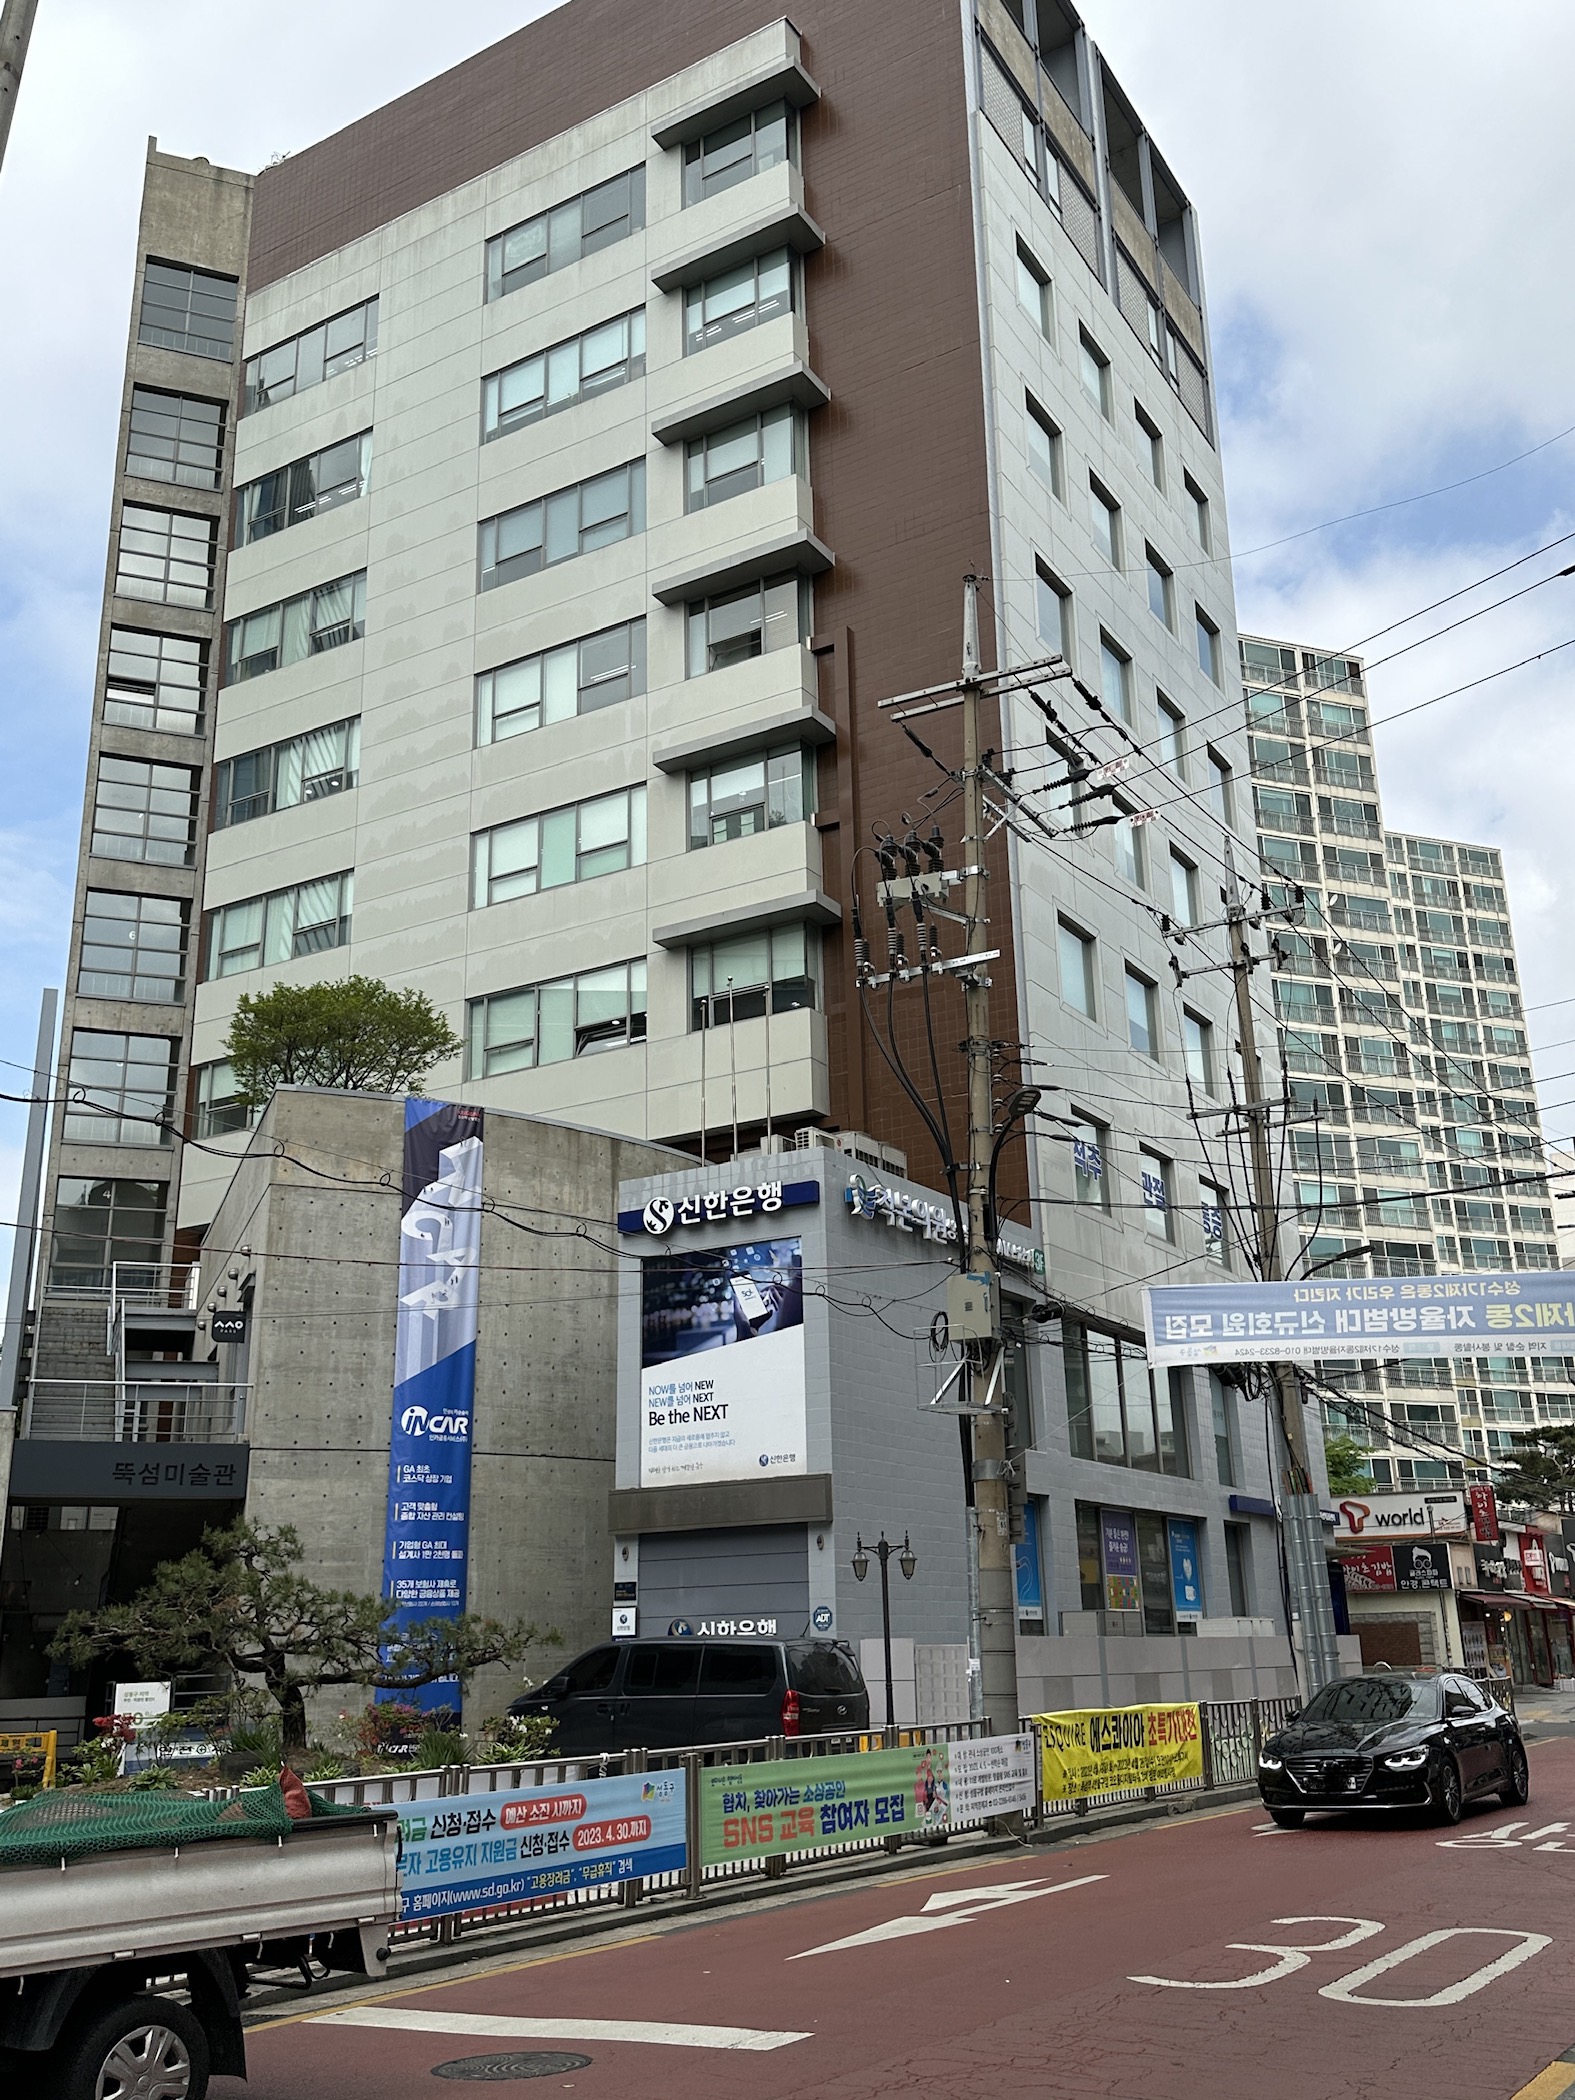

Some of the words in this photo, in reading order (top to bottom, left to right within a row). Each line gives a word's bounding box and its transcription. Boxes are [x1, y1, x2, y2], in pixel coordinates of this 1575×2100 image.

[678, 1180, 783, 1225] 신한은행
[695, 1379, 714, 1390] NEW
[693, 1392, 714, 1403] NEXT
[649, 1411, 665, 1426] Be
[668, 1408, 690, 1424] the
[693, 1404, 729, 1422] NEXT
[770, 1453, 796, 1464] 신한은행
[112, 1462, 237, 1486] 뚝섬미술관
[403, 1474, 424, 1483] 코스닥
[1375, 1508, 1424, 1526] world
[816, 1613, 830, 1623] ADT
[1090, 1713, 1145, 1753] 에스콰이아
[656, 1781, 675, 1797] 성동구
[754, 1787, 800, 1809] 찾아가는
[803, 1780, 846, 1803] 소상공인
[529, 1802, 550, 1821] 소진
[552, 1798, 582, 1817] 시까지
[723, 1813, 774, 1849] SNS
[780, 1806, 815, 1841] 교육
[820, 1799, 870, 1835] 참여자
[875, 1794, 905, 1824] 모집
[425, 1843, 477, 1873] 고용유지
[481, 1838, 517, 1864] 지원금
[578, 1827, 604, 1847] 2023.
[606, 1824, 615, 1841] 4.
[402, 1897, 410, 1913] 구
[618, 1858, 633, 1875] 검색
[1126, 1915, 1553, 2007] 30
